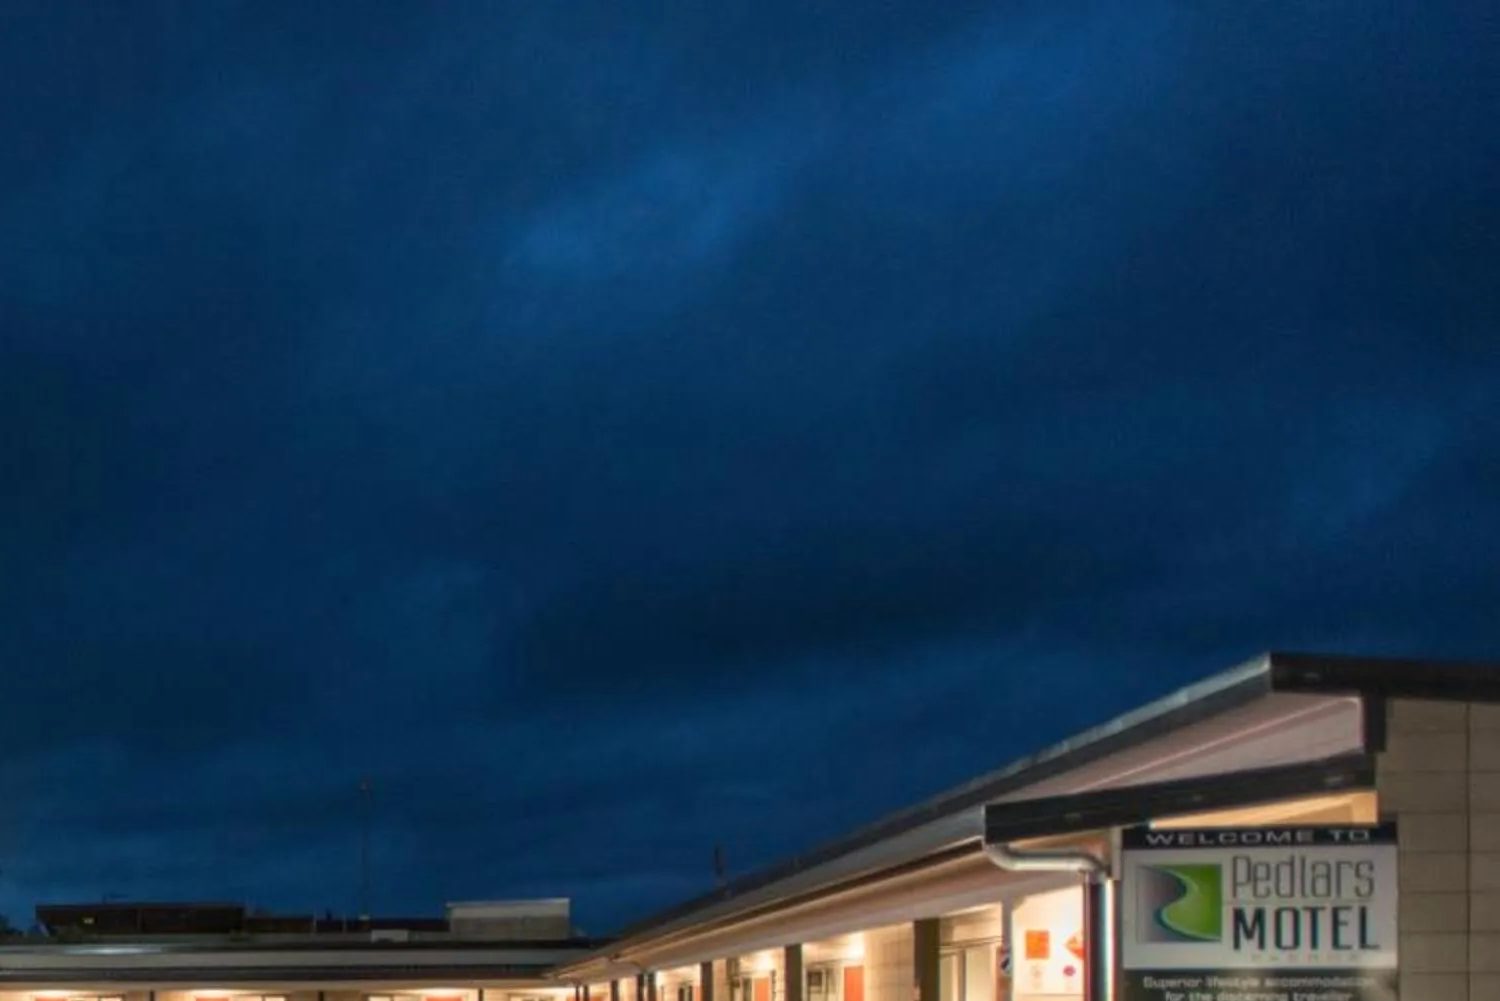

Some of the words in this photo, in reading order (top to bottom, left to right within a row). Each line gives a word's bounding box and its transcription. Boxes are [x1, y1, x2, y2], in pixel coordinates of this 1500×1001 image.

[1145, 830, 1314, 846] WELCOME
[1328, 829, 1370, 842] TO
[1232, 855, 1375, 899] Pedlars
[1233, 905, 1381, 951] MOTEL
